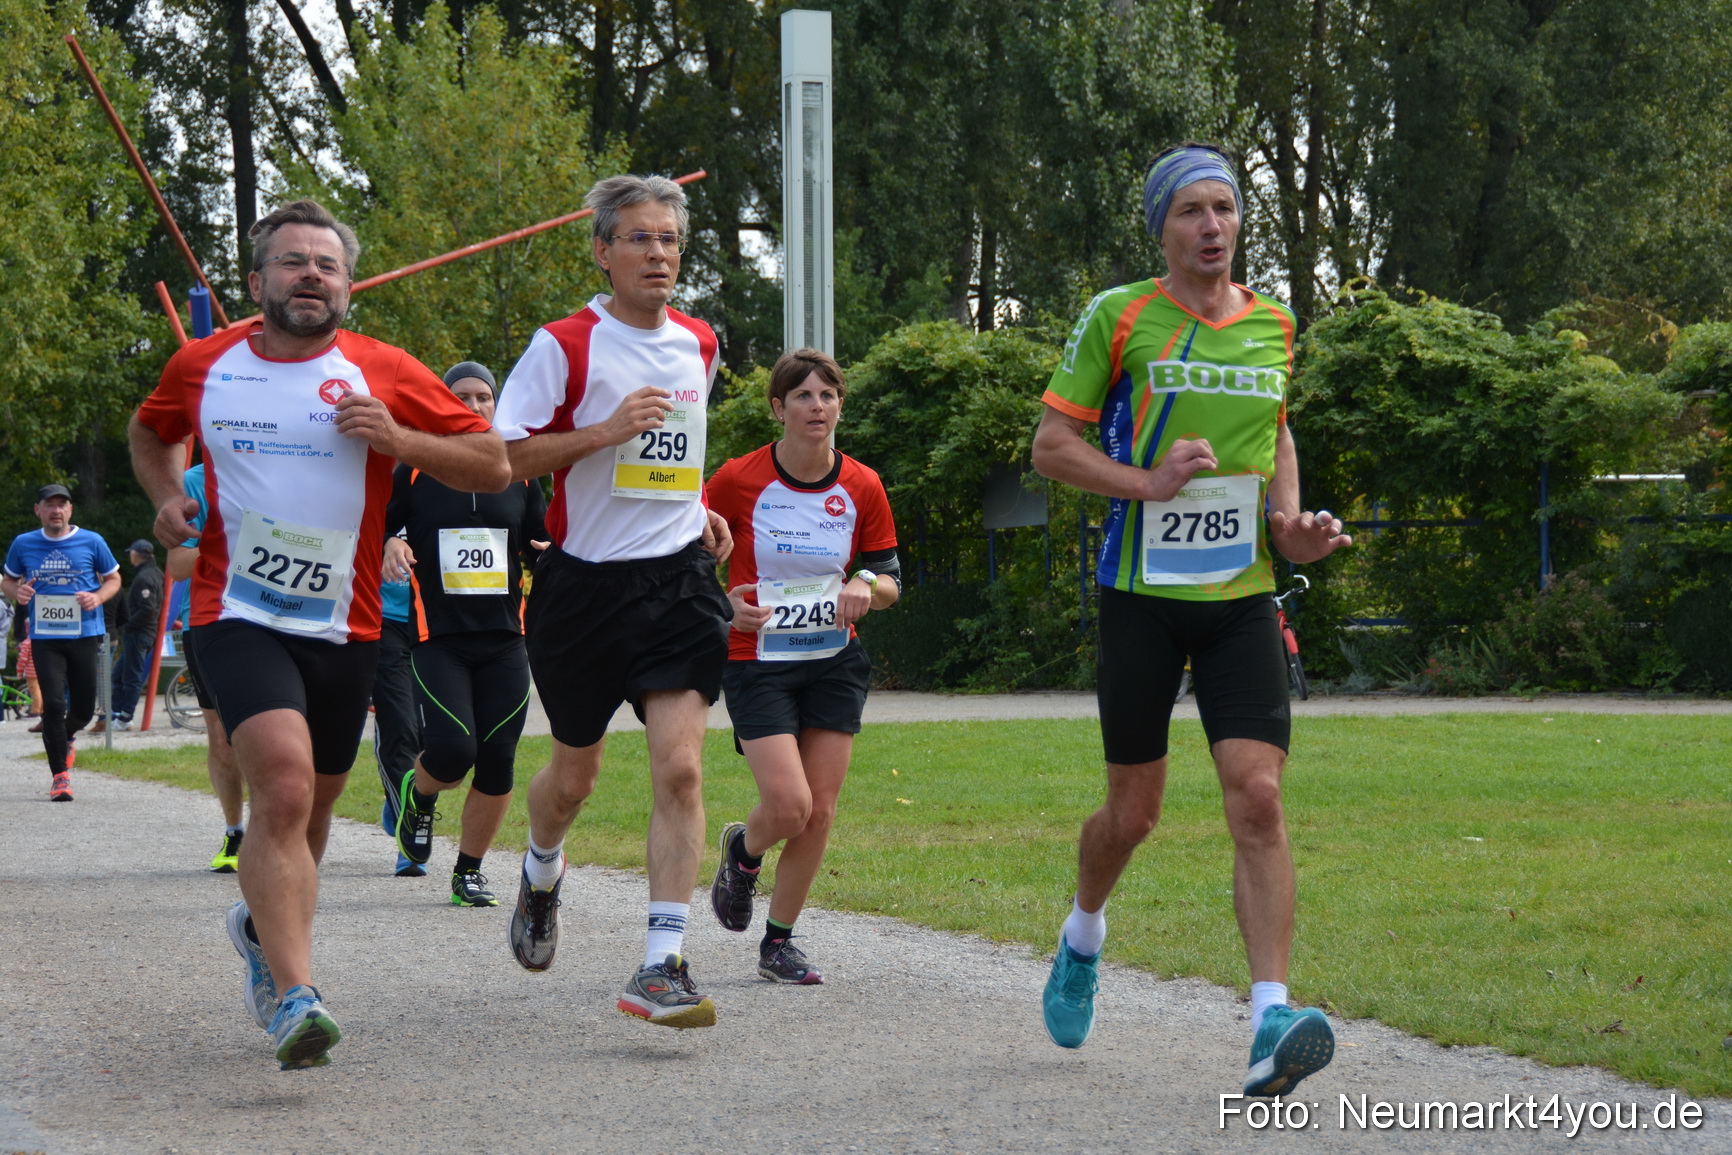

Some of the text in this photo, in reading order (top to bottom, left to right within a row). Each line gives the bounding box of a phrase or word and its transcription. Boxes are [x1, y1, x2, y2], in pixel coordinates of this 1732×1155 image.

[1147, 360, 1283, 402] BOCK
[675, 390, 699, 402] MID
[663, 410, 687, 420] OCK
[212, 419, 278, 430] MICHAEL KLEIN
[258, 441, 313, 450] Raiffeisenbank
[639, 430, 688, 462] 259
[259, 448, 295, 457] Neumarkt
[323, 450, 334, 458] eG
[648, 471, 676, 483] Albert
[1188, 486, 1228, 498] BOCK
[819, 521, 847, 530] KOPPE
[1161, 508, 1240, 543] 2785
[282, 531, 324, 548] BOCK
[457, 548, 494, 569] 290
[247, 545, 332, 593] 2275
[792, 583, 825, 593] BOCK
[259, 590, 304, 611] Michael
[42, 606, 74, 620] 2604
[774, 600, 836, 630] 2243
[788, 635, 825, 646] Stefanie
